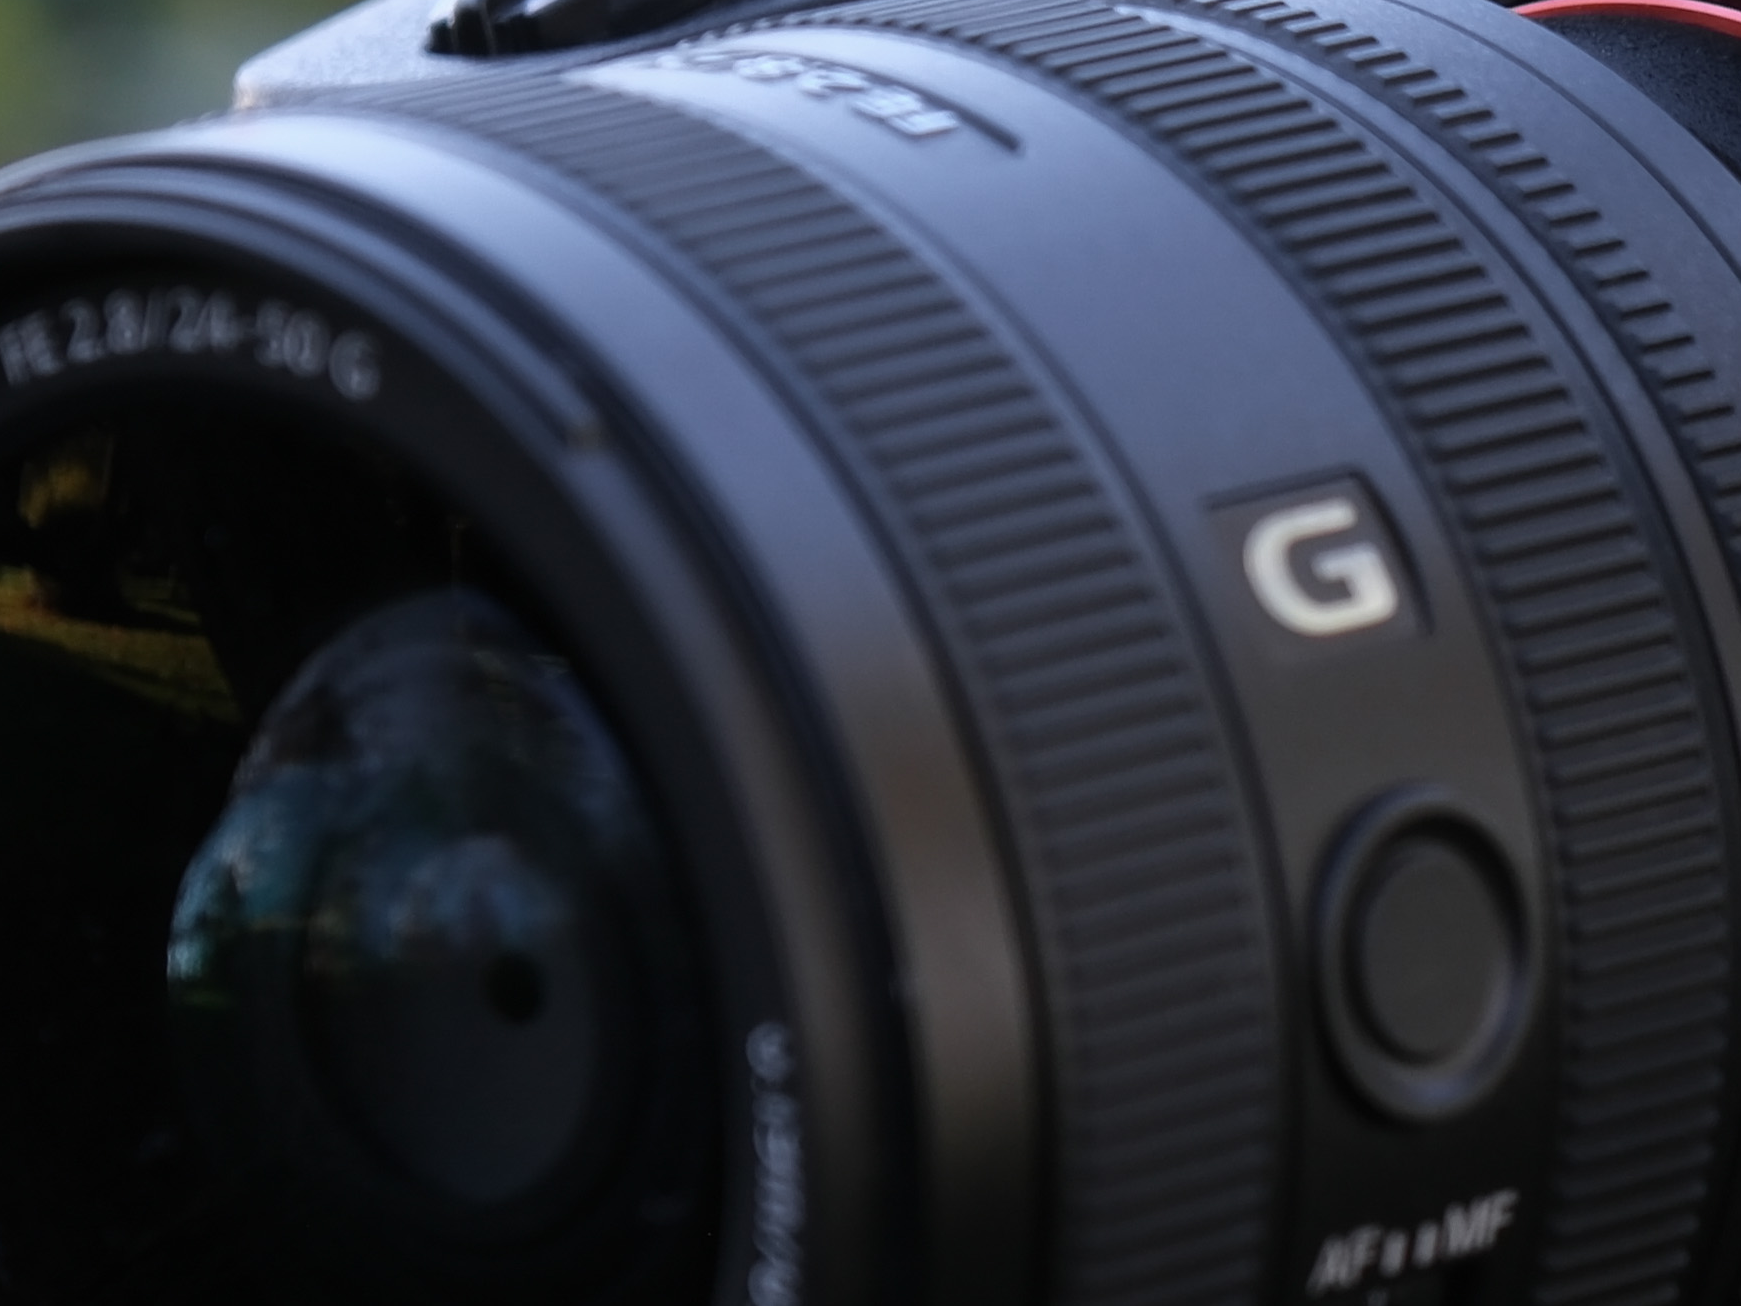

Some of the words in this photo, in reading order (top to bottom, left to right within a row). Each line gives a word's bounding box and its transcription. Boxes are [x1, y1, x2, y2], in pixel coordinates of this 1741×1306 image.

[59, 284, 332, 378] 2.8/24-50
[328, 328, 384, 401] G
[1243, 498, 1397, 637] G
[1306, 1223, 1383, 1299] AF
[1440, 1187, 1520, 1263] MF
